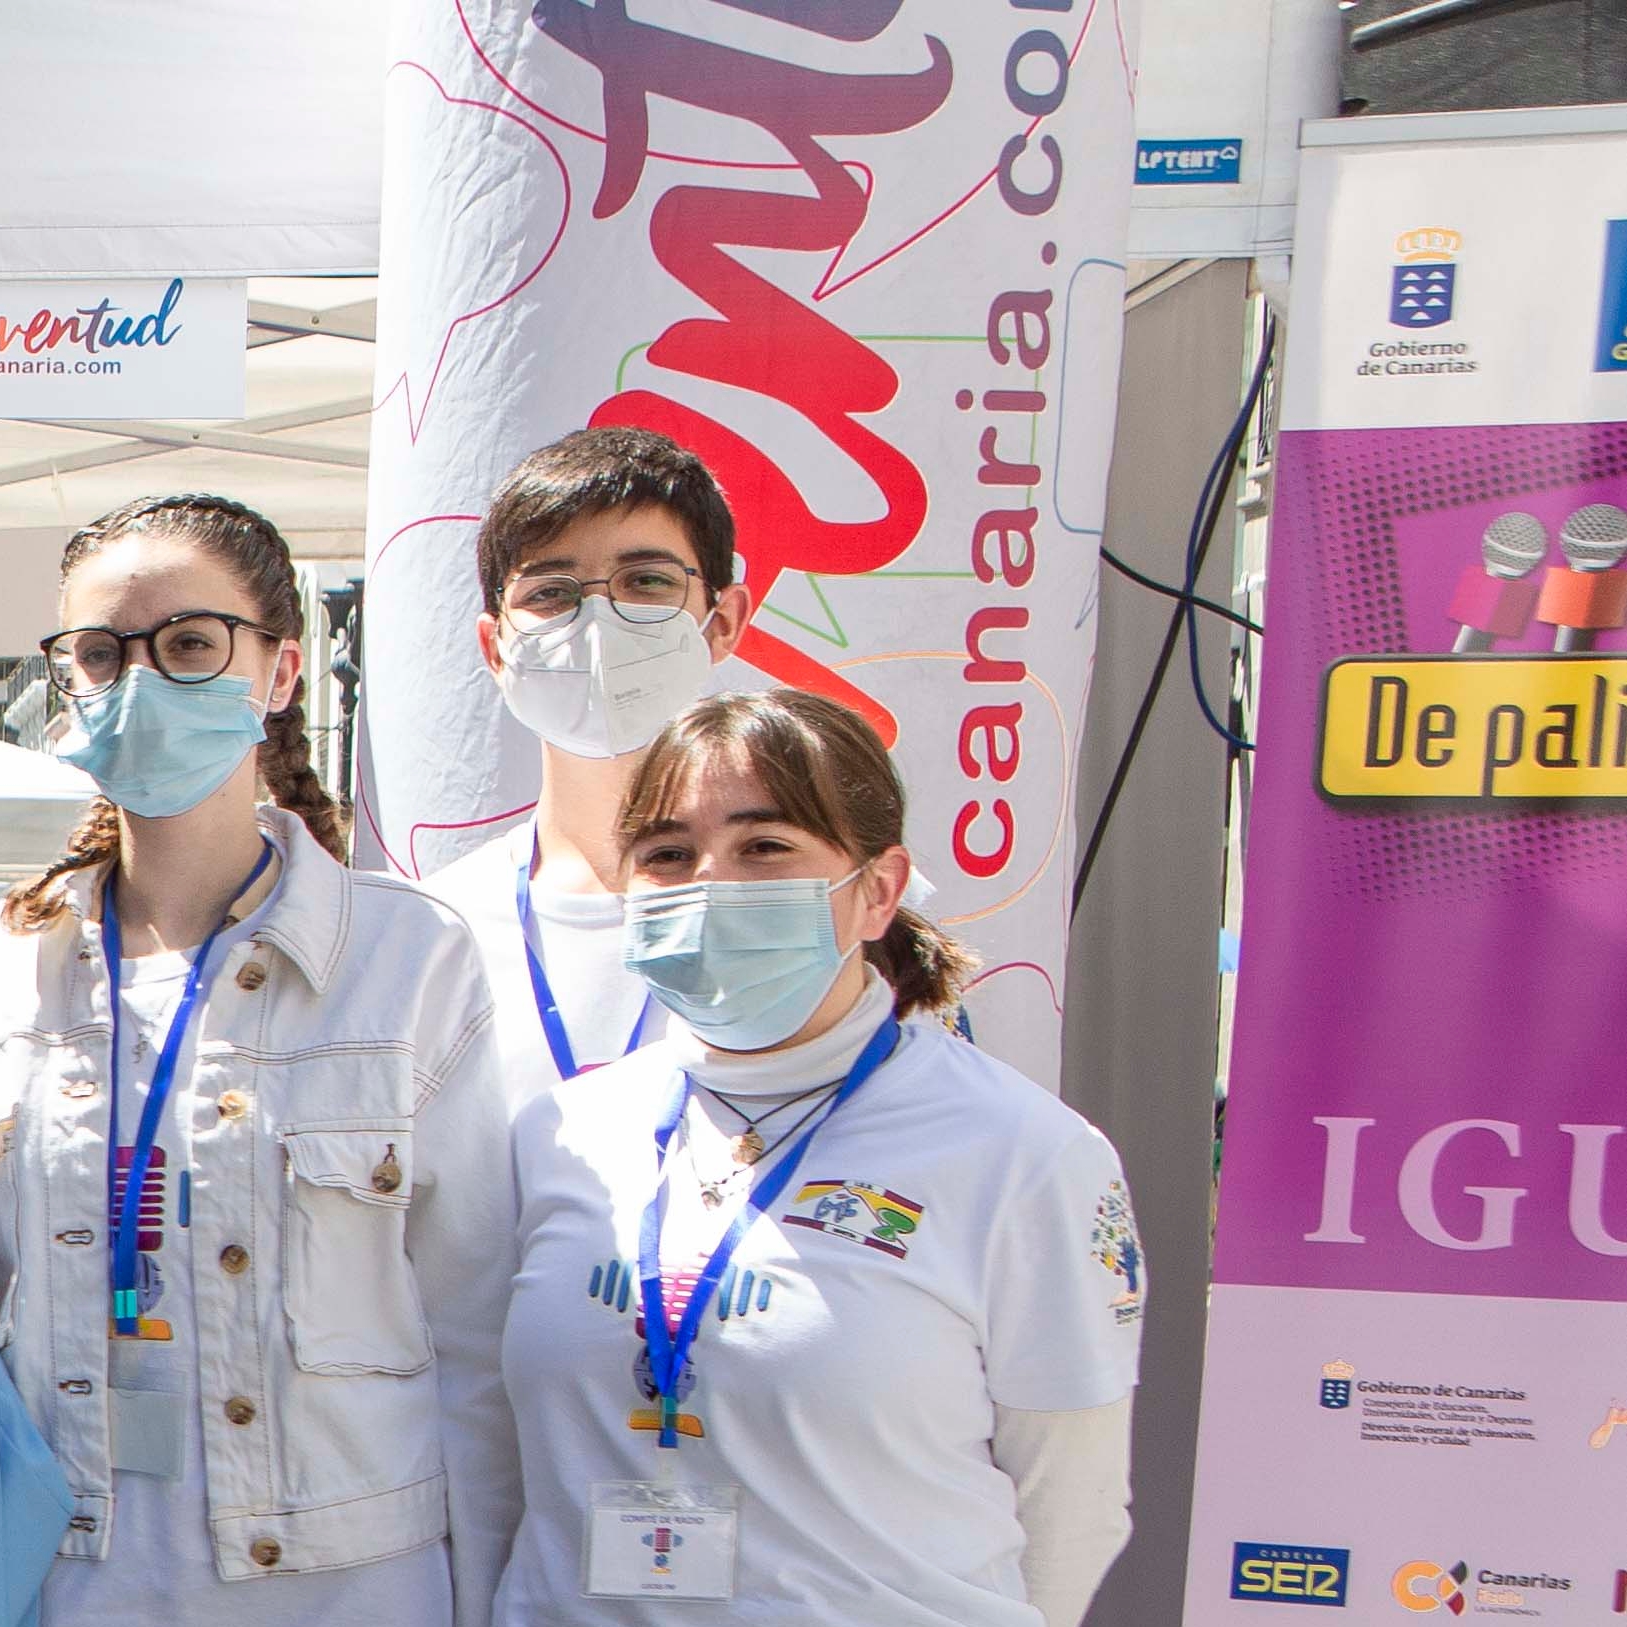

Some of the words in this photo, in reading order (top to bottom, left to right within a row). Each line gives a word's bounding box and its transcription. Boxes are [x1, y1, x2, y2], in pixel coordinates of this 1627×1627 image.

[1369, 341, 1468, 358] Gobierno
[1357, 361, 1381, 376] de
[1385, 358, 1479, 376] Canarias
[952, 0, 1074, 880] canaria.co
[1363, 674, 1457, 770] De
[1357, 1380, 1431, 1396] Gobierno
[1433, 1383, 1453, 1397] de
[1455, 1385, 1528, 1401] Canarias
[1238, 1559, 1341, 1598] SER
[1478, 1569, 1572, 1592] Canarias
